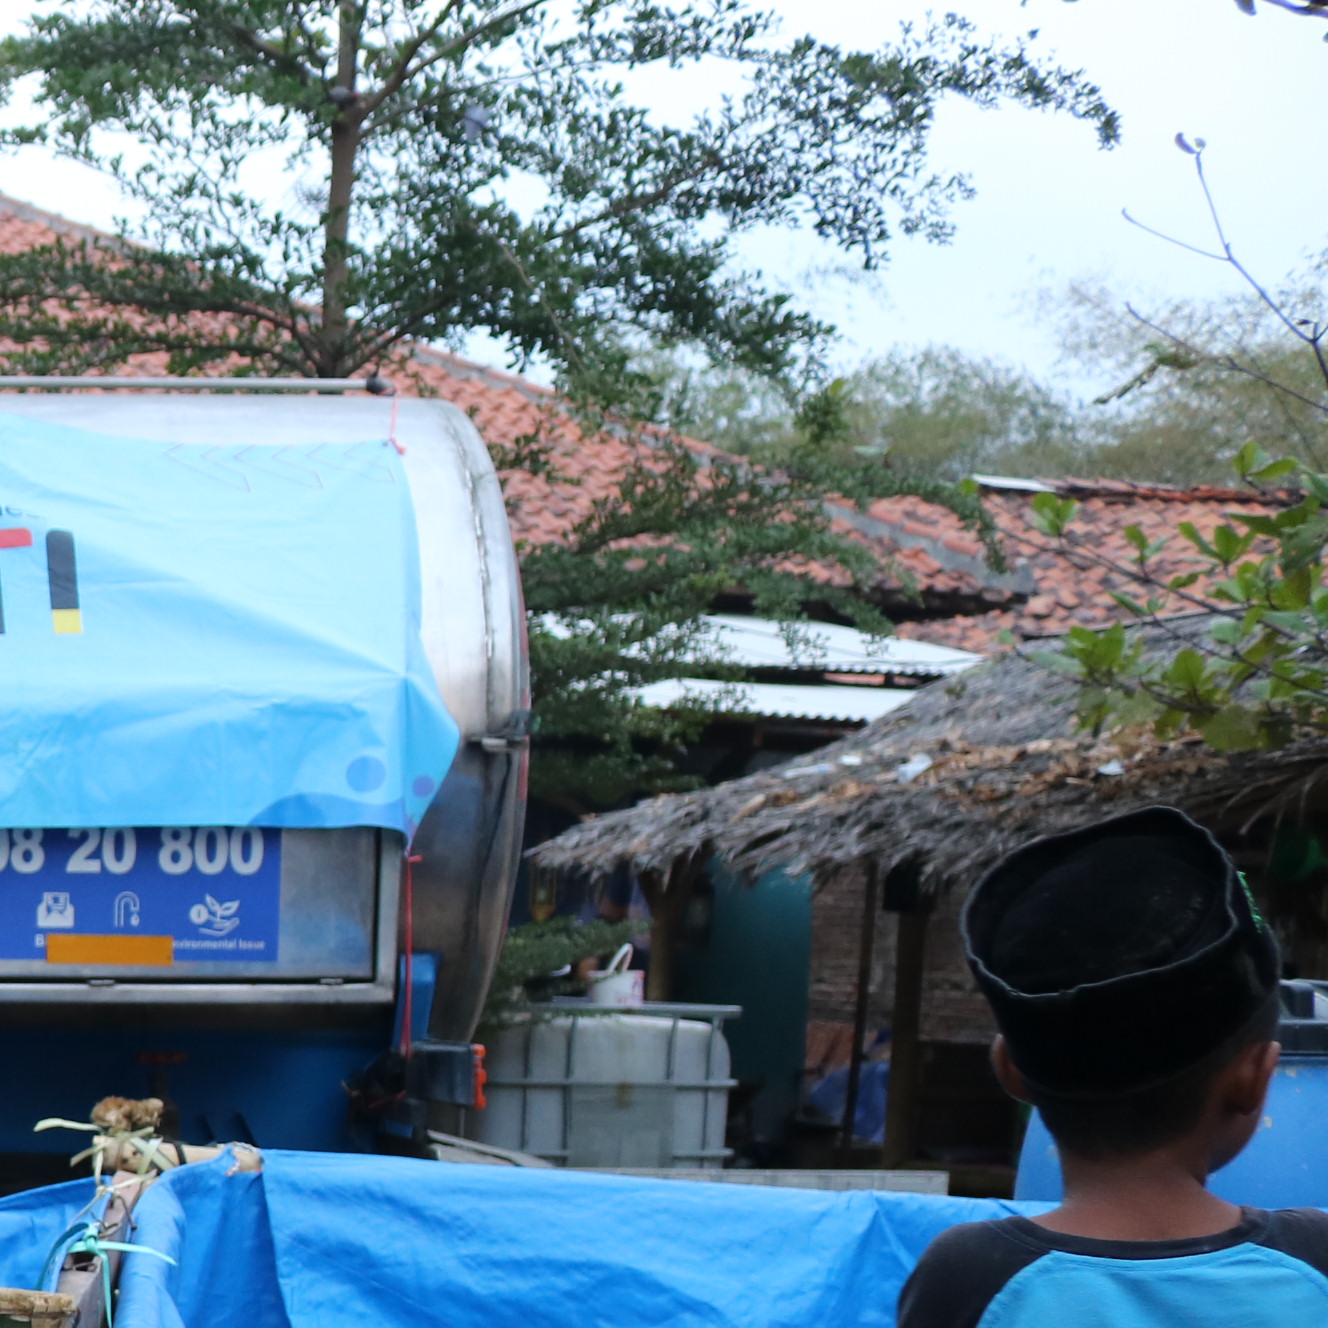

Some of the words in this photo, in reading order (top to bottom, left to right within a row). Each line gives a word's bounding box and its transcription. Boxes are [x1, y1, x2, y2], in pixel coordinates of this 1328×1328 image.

[65, 828, 137, 874] 20
[158, 827, 265, 875] 800
[172, 938, 237, 950] nvironmental
